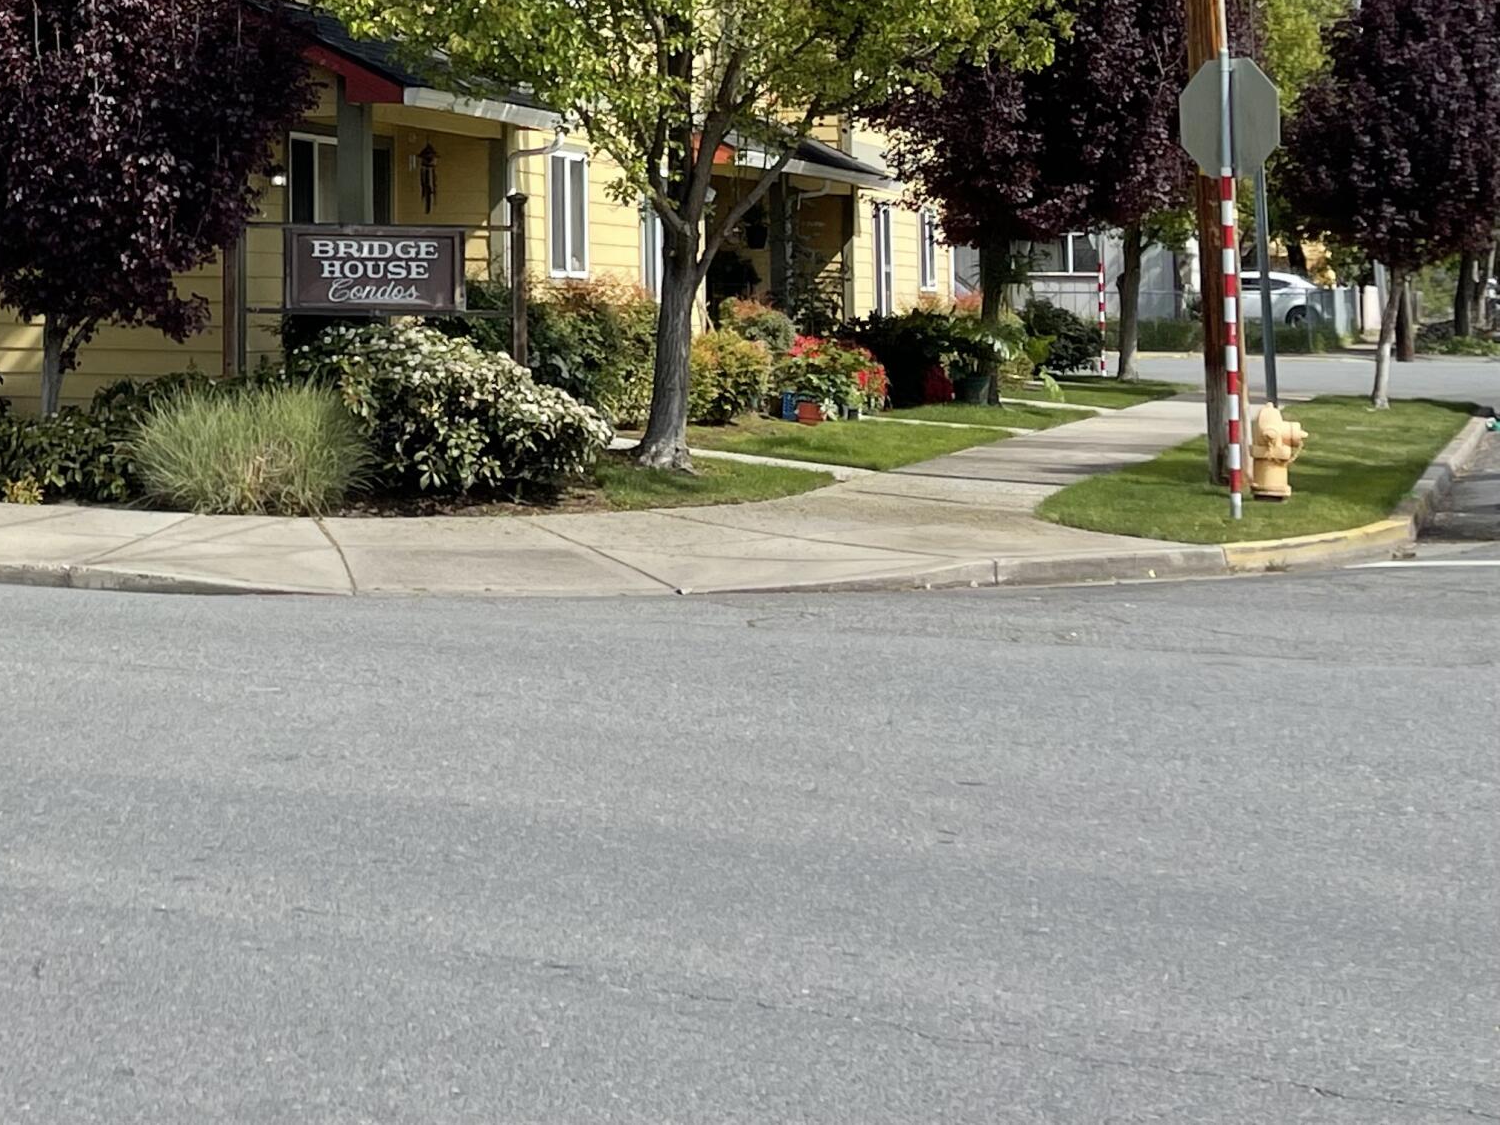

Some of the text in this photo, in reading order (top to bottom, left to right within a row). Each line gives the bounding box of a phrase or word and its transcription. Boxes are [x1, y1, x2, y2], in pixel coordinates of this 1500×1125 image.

[311, 240, 438, 259] BRIDGE
[321, 261, 429, 279] HOUSE
[328, 279, 421, 302] Condos
